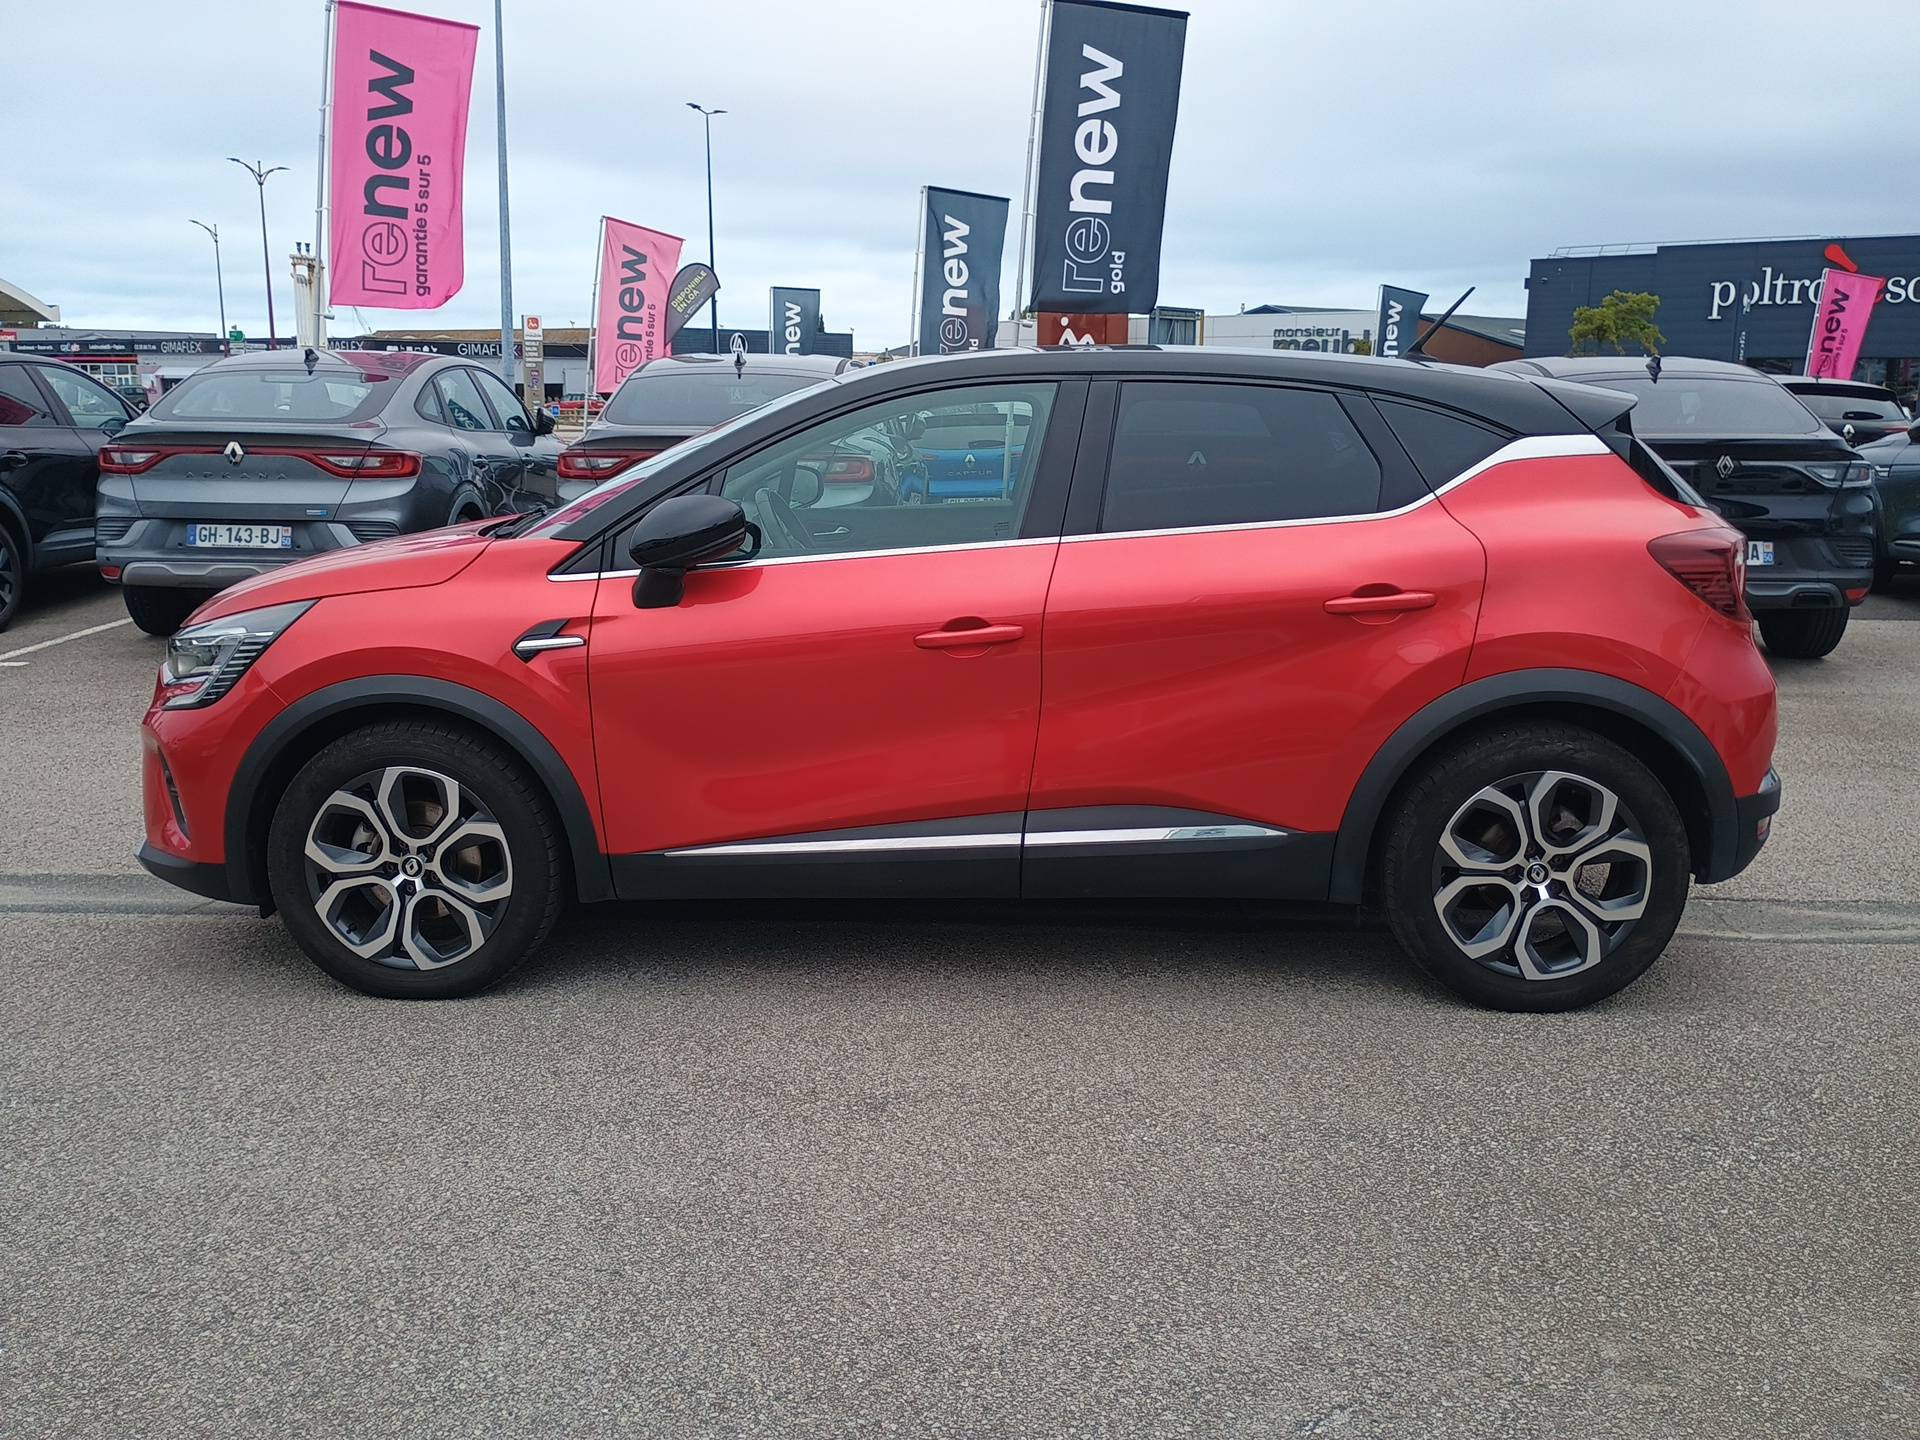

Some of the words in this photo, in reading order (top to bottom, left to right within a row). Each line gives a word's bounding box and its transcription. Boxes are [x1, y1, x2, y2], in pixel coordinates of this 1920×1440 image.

[417, 154, 432, 166] 5
[1063, 43, 1124, 293] renew
[362, 48, 415, 295] renew
[418, 169, 431, 200] sur
[415, 203, 429, 214] 5
[413, 217, 431, 297] garantie
[1110, 251, 1126, 295] gold
[671, 270, 708, 308] DISPONIBLE
[676, 300, 688, 313] EN
[684, 290, 701, 304] LOA
[648, 312, 656, 330] sur
[784, 301, 802, 355] new
[1383, 300, 1403, 357] new
[1273, 326, 1341, 338] monsieur
[160, 341, 202, 353] GIMAFLEX
[328, 341, 364, 351] MAFLEX
[457, 343, 520, 357] GIMAFLX
[645, 341, 654, 360] ntie
[968, 338, 979, 351] ld
[185, 471, 288, 480] ARKANA
[198, 526, 281, 545] GH-143-BJ
